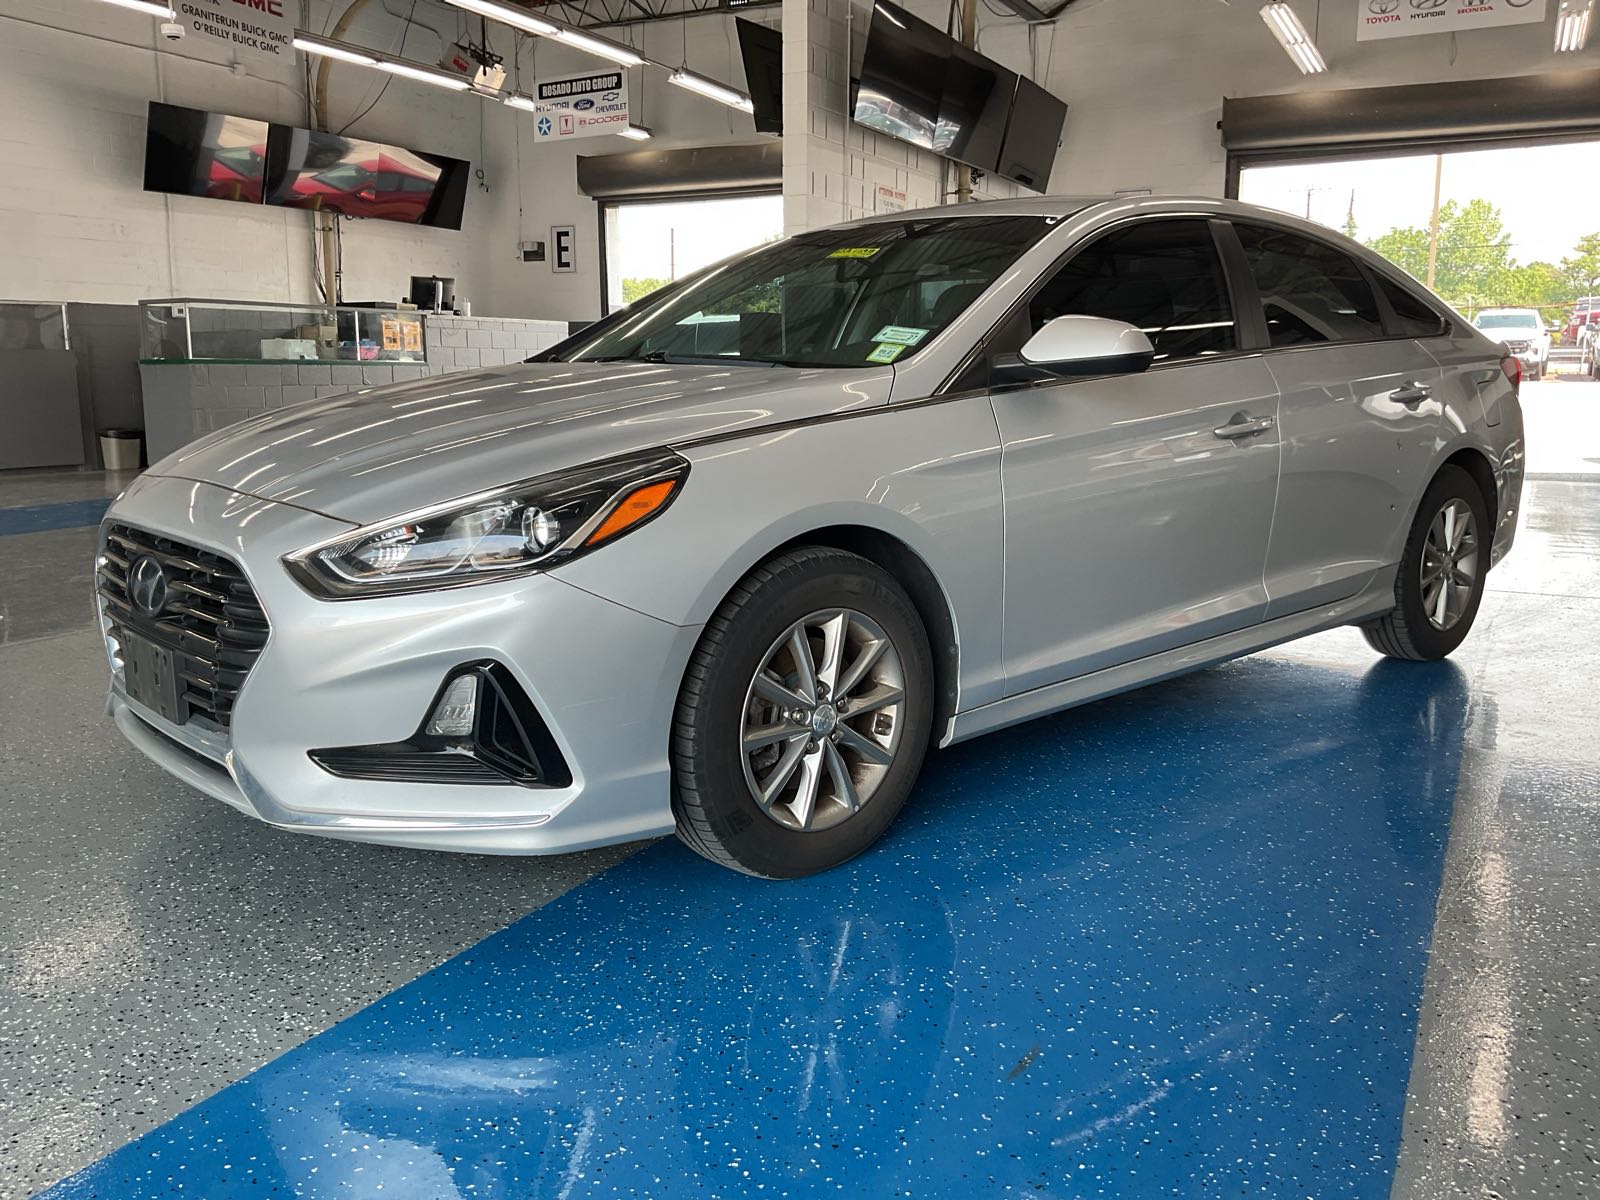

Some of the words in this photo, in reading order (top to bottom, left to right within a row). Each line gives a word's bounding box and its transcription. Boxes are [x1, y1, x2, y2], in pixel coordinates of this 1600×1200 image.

[1410, 10, 1446, 20] HYUNDAI
[1457, 5, 1494, 14] HONDA
[181, 3, 239, 29] GRANITERUN
[241, 22, 267, 39] BUICK
[268, 31, 288, 45] GMC
[1366, 14, 1400, 25] TOYOTA
[193, 21, 230, 40] O'REILLY
[232, 33, 258, 49] BUICK
[260, 42, 280, 55] GMC
[542, 82, 571, 97] ROSADO
[572, 79, 591, 93] AUTO
[592, 75, 618, 90] GROUP
[536, 101, 569, 113] HYUNDAI
[596, 103, 627, 113] CHEVROLET
[588, 114, 628, 125] DODGE
[556, 231, 570, 268] E
